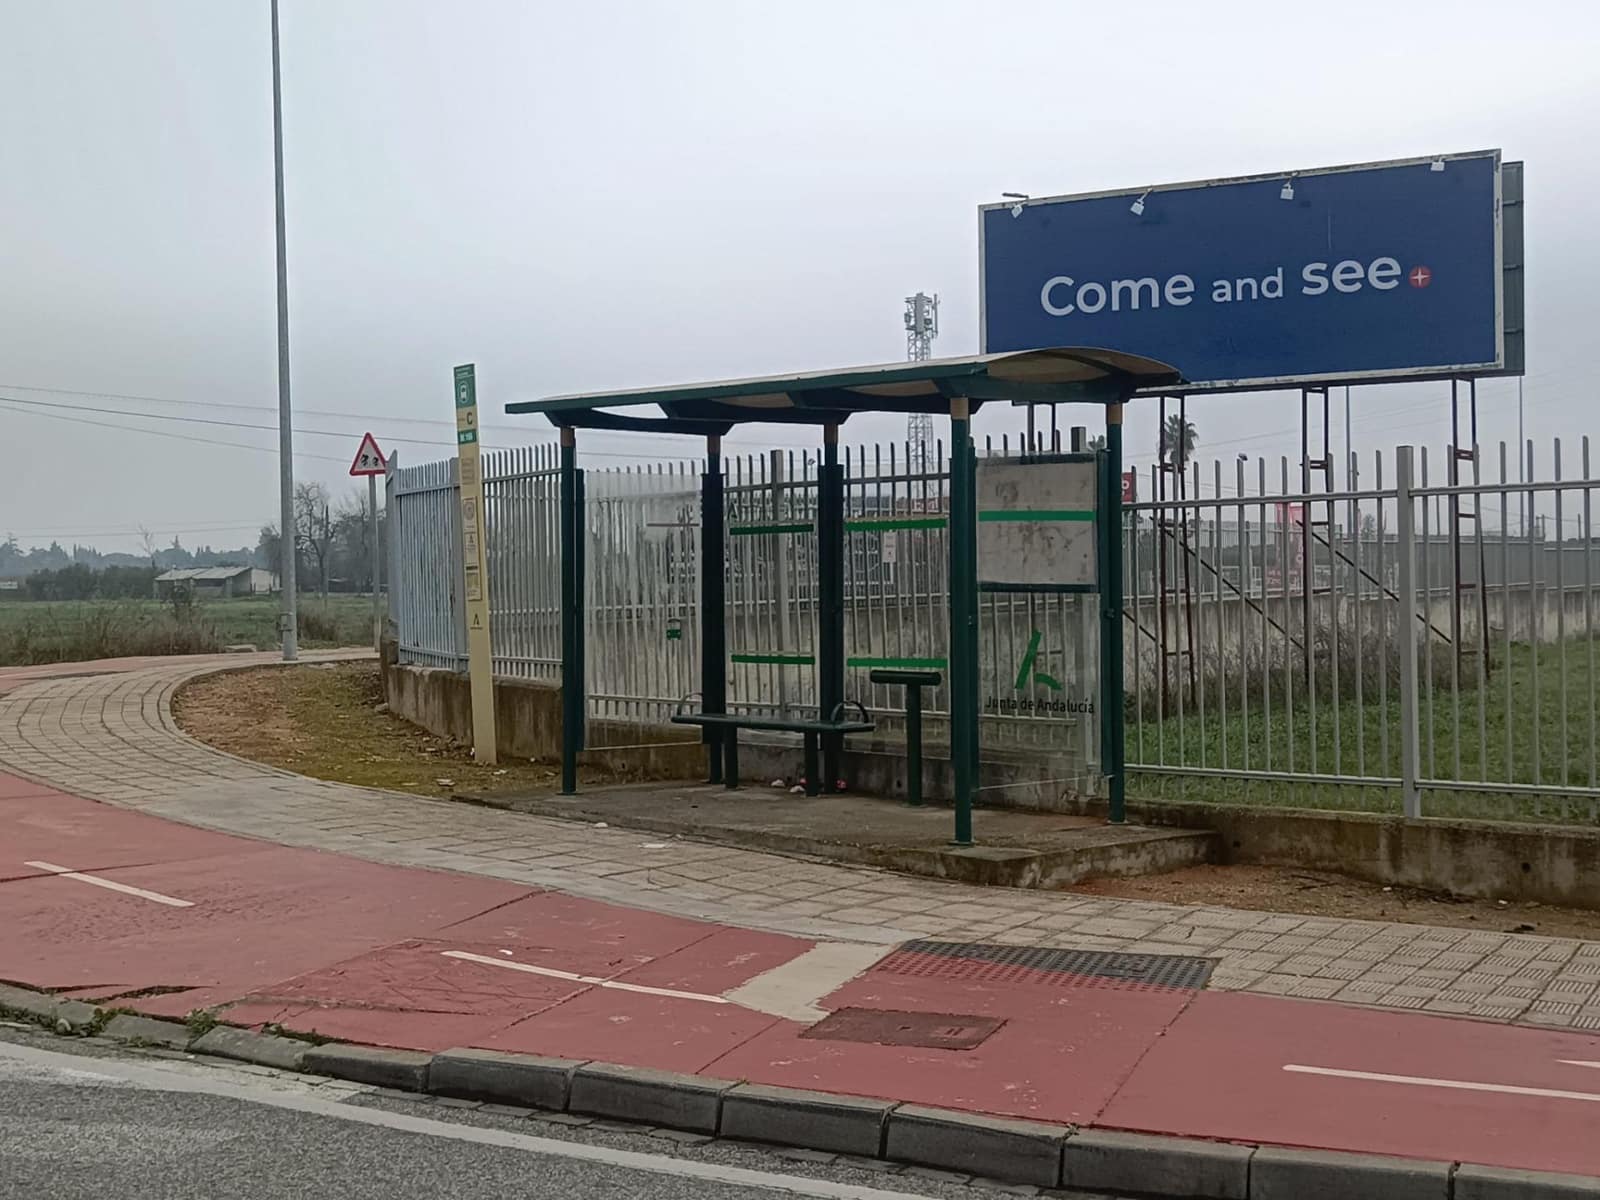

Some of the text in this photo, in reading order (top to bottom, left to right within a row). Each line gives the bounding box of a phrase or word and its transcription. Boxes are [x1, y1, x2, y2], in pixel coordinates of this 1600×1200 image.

[1040, 256, 1402, 317] Come and see
[466, 411, 473, 425] C
[985, 696, 1095, 714] Junta de Andalucía
